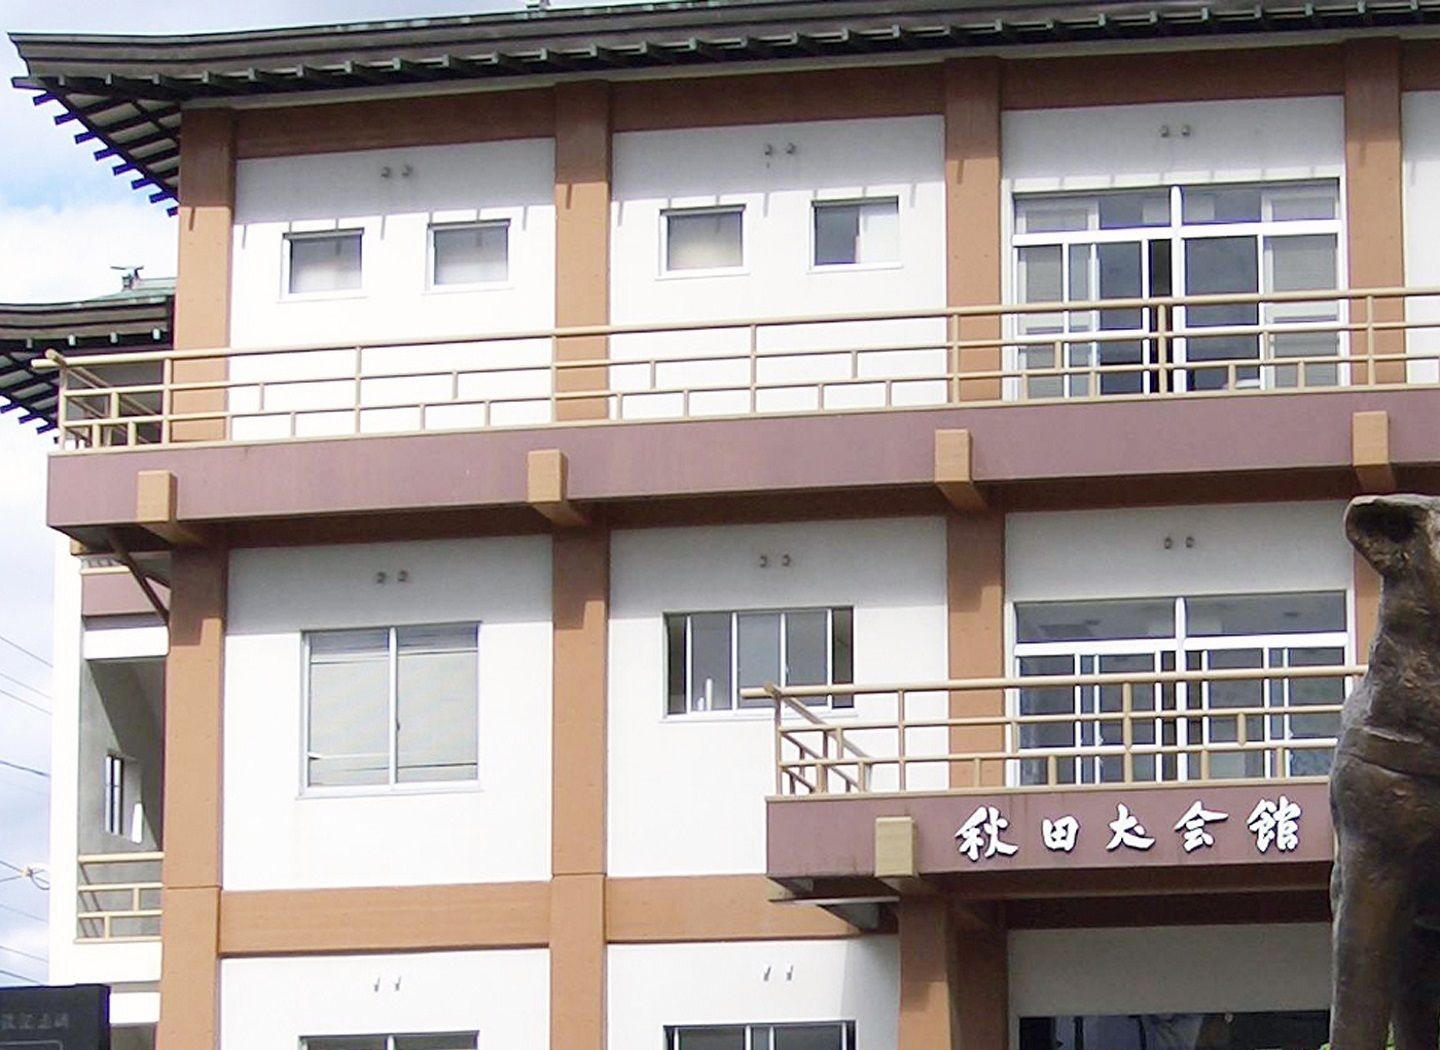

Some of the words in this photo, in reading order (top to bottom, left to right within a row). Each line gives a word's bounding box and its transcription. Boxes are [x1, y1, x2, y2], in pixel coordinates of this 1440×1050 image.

[954, 795, 1302, 862] 秋田犬会館
